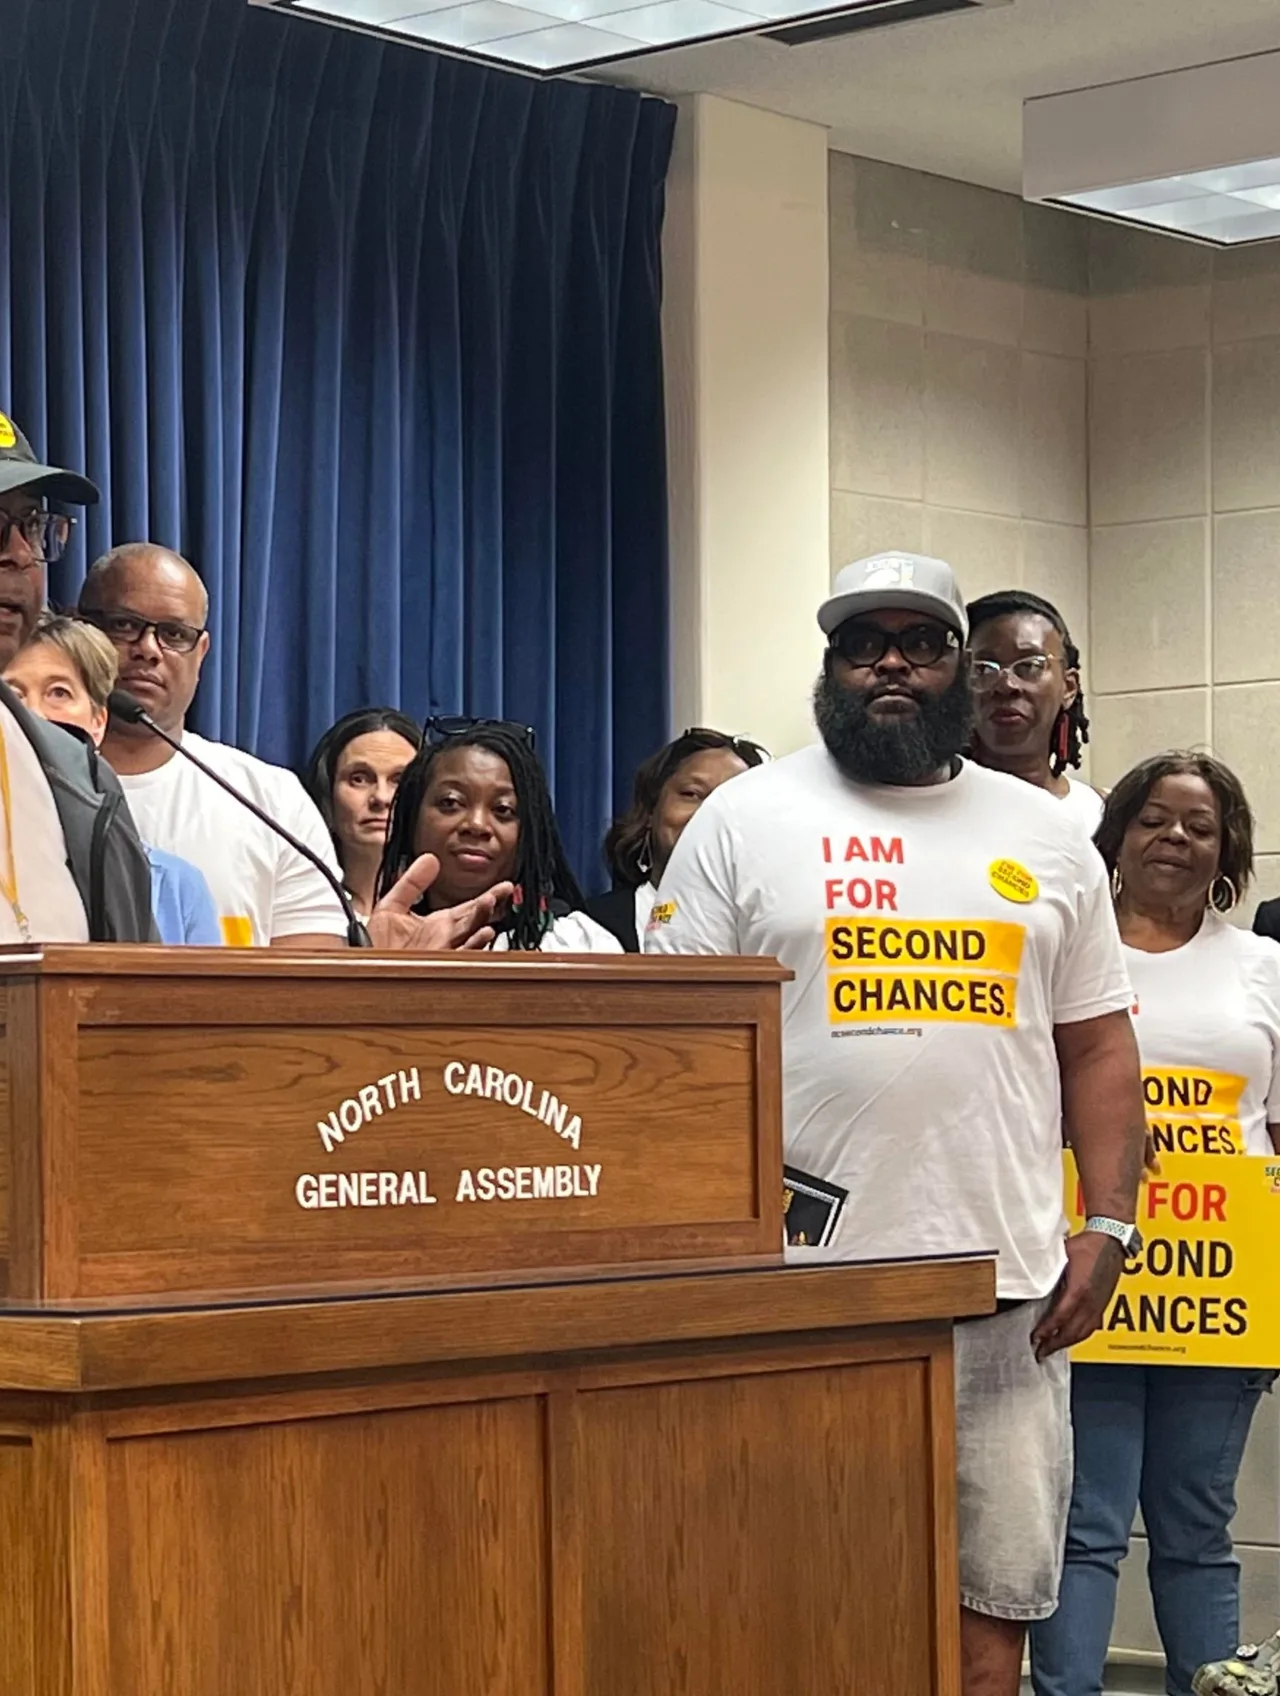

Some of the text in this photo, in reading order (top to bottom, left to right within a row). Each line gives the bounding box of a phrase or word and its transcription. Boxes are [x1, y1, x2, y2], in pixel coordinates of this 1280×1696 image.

[822, 836, 904, 865] I AM
[824, 877, 898, 911] FOR
[831, 926, 986, 961] SECOND
[833, 978, 1012, 1019] CHANCES.
[316, 1061, 583, 1152] NORTH CAROLINA
[295, 1164, 602, 1209] GENERAL ASSEMBLY
[1147, 1182, 1228, 1222] FOR
